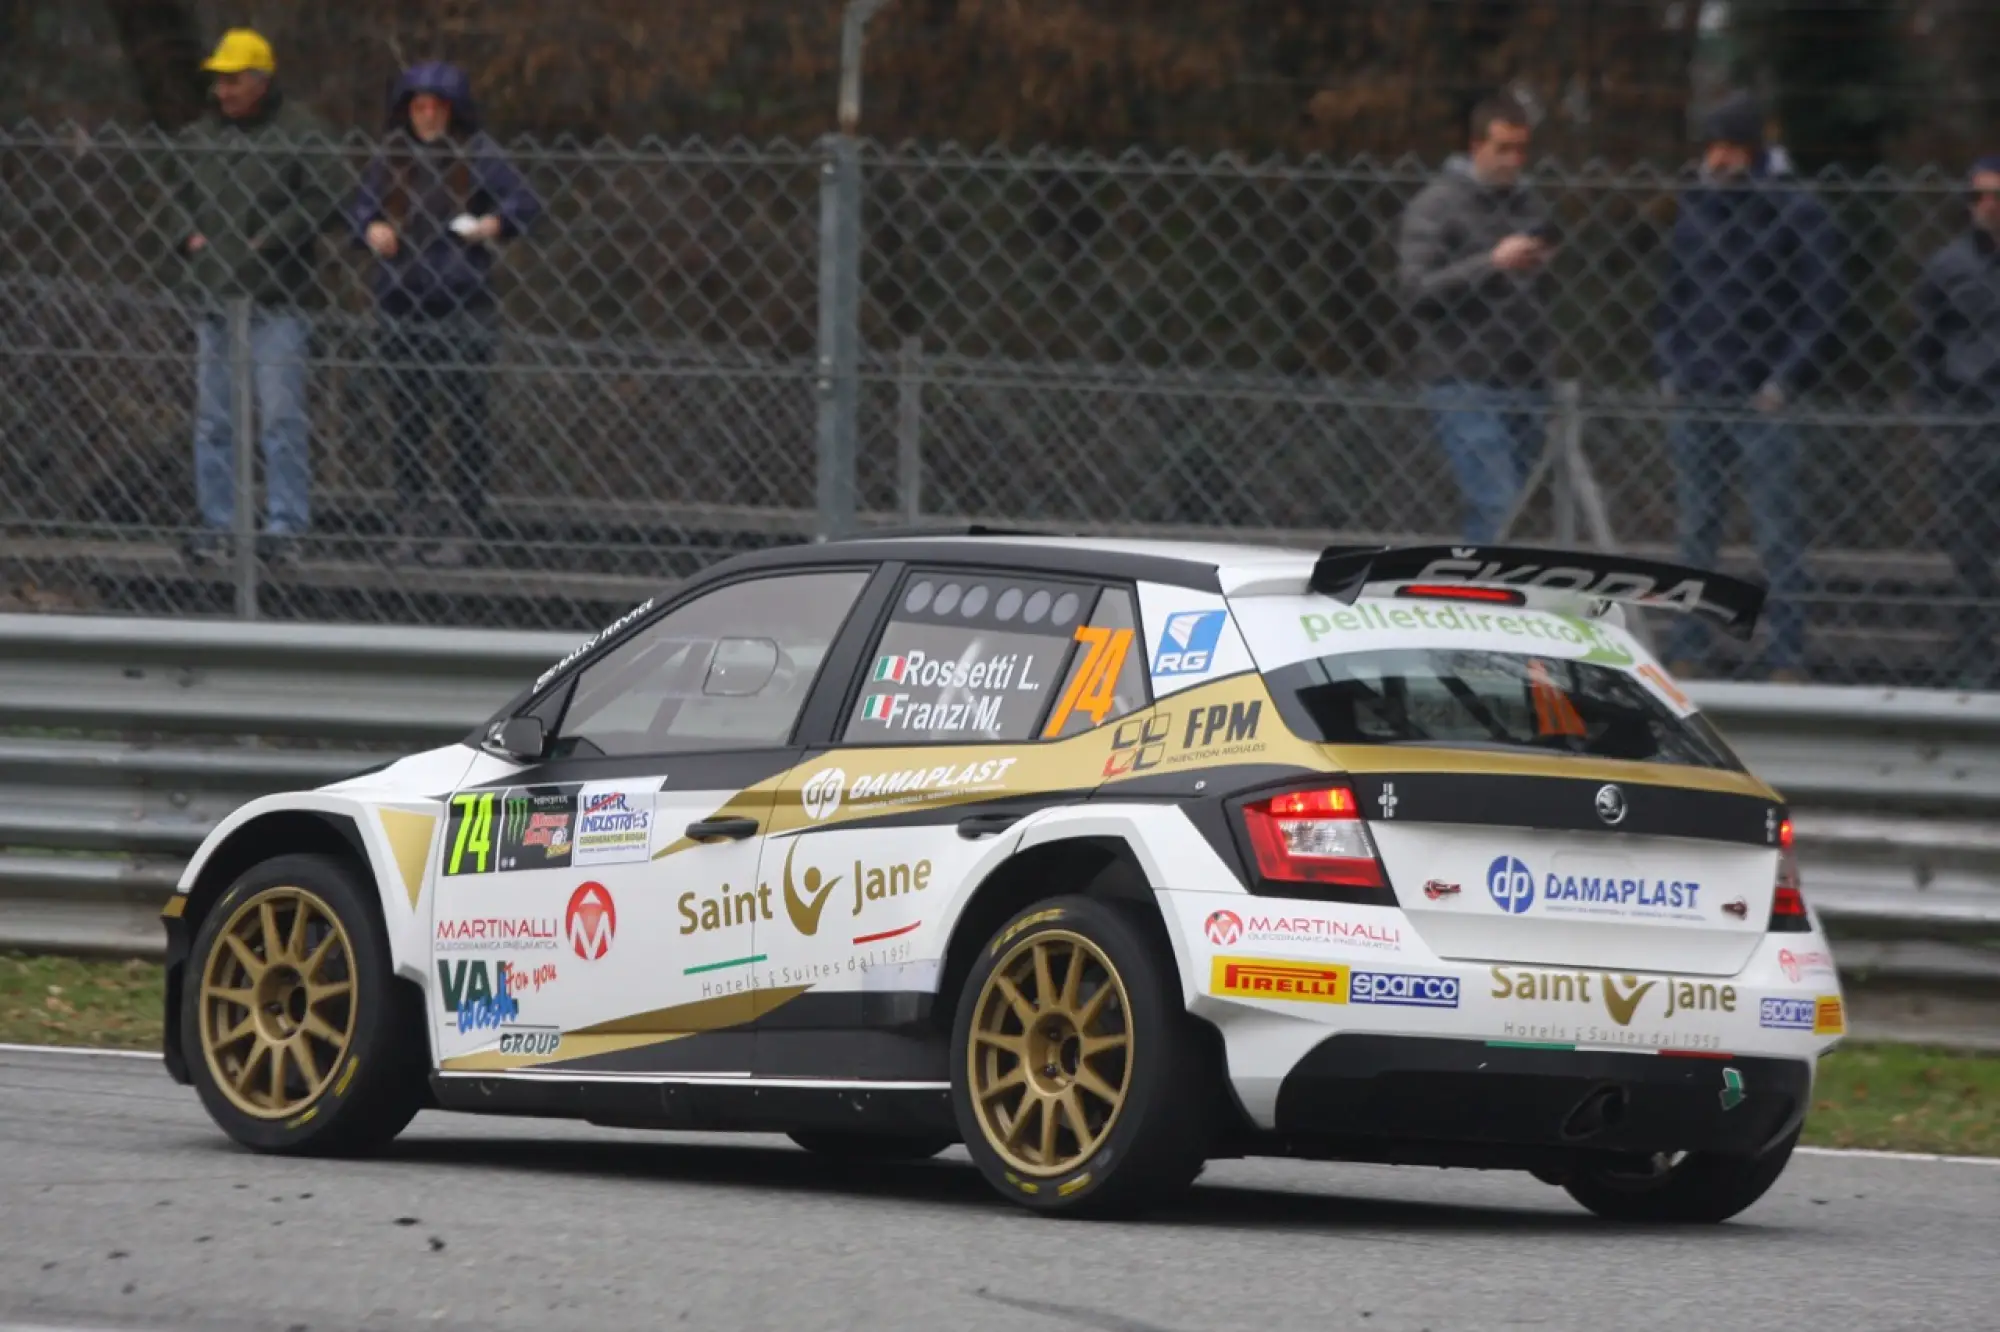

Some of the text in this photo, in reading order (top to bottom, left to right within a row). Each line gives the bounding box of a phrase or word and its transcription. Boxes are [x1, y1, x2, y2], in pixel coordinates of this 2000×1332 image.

[903, 650, 1040, 692] Rossetti L.
[1154, 652, 1210, 671] RG
[1043, 625, 1135, 738] 74
[886, 693, 1003, 732] Franzi M.
[1183, 700, 1263, 750] FPM
[1166, 742, 1267, 764] INJECTION MOULDS
[849, 757, 1018, 800] DAMAPLAST
[447, 791, 496, 875] 74
[677, 859, 932, 935] Saint Jane
[1544, 872, 1702, 910] DAMAPLAST
[437, 918, 558, 939] MARTINALLI
[1248, 916, 1400, 943] MARTINALLI
[532, 963, 558, 994] you
[702, 973, 761, 998] Hotels
[783, 962, 841, 984] Suites
[847, 951, 875, 974] dal
[1225, 963, 1338, 996] PIRELLI
[1352, 973, 1458, 1003] sparco
[1489, 964, 1738, 1019] Saint Jane
[499, 1031, 560, 1055] GROUP
[1503, 1021, 1566, 1038] Hotels
[1587, 1025, 1645, 1045] Suites
